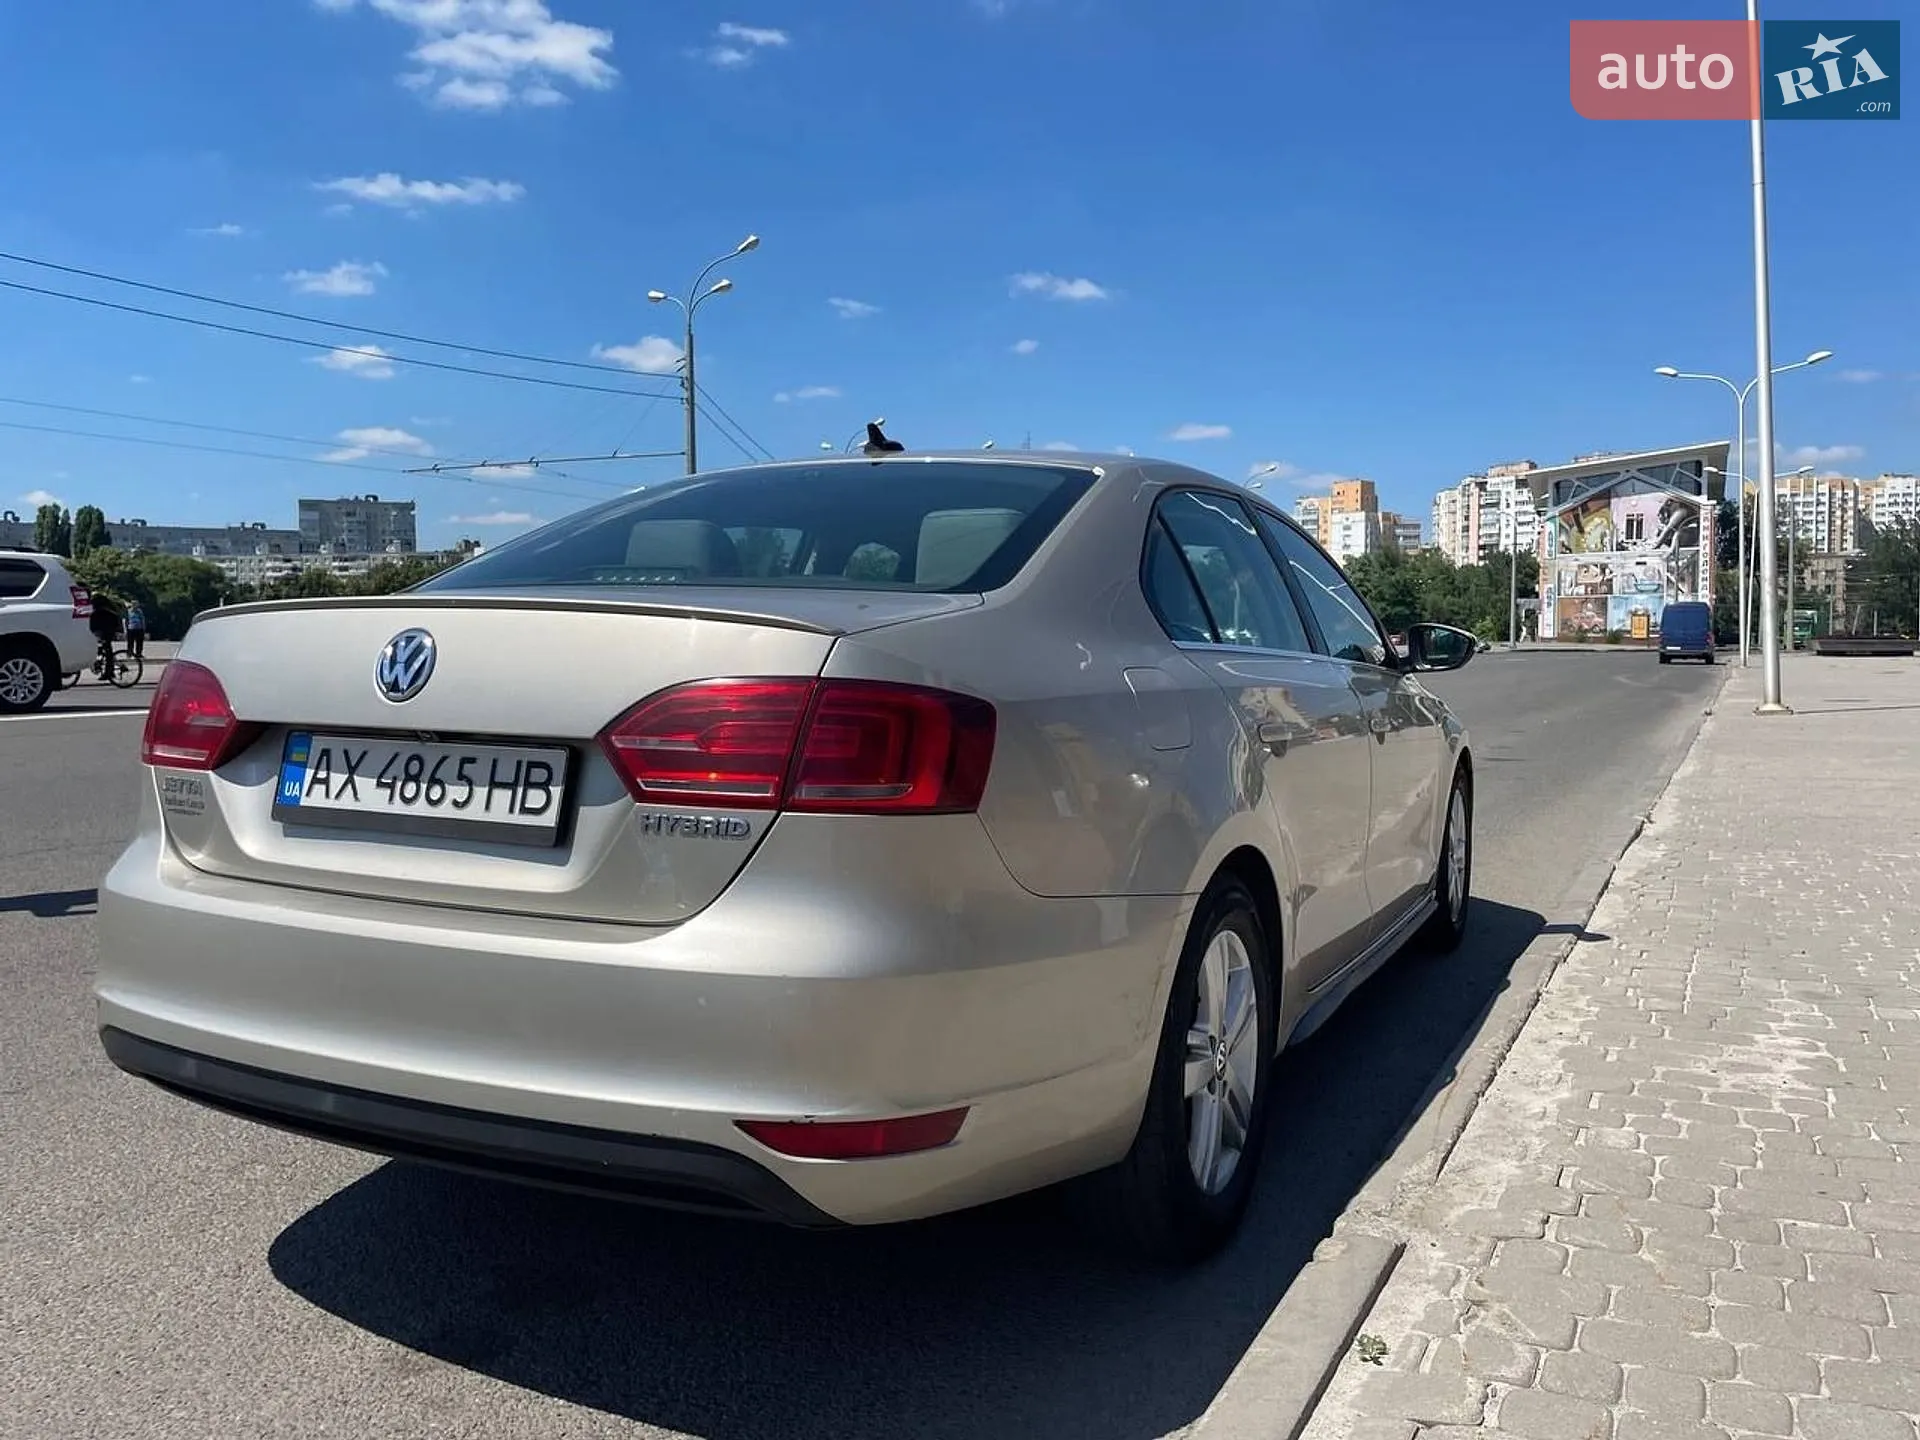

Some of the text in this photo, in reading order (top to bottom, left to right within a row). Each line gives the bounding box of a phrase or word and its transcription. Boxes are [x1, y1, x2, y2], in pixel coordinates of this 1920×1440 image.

[284, 780, 300, 797] UA
[305, 747, 554, 816] AX 4865 HB
[640, 813, 751, 838] HYBRID
